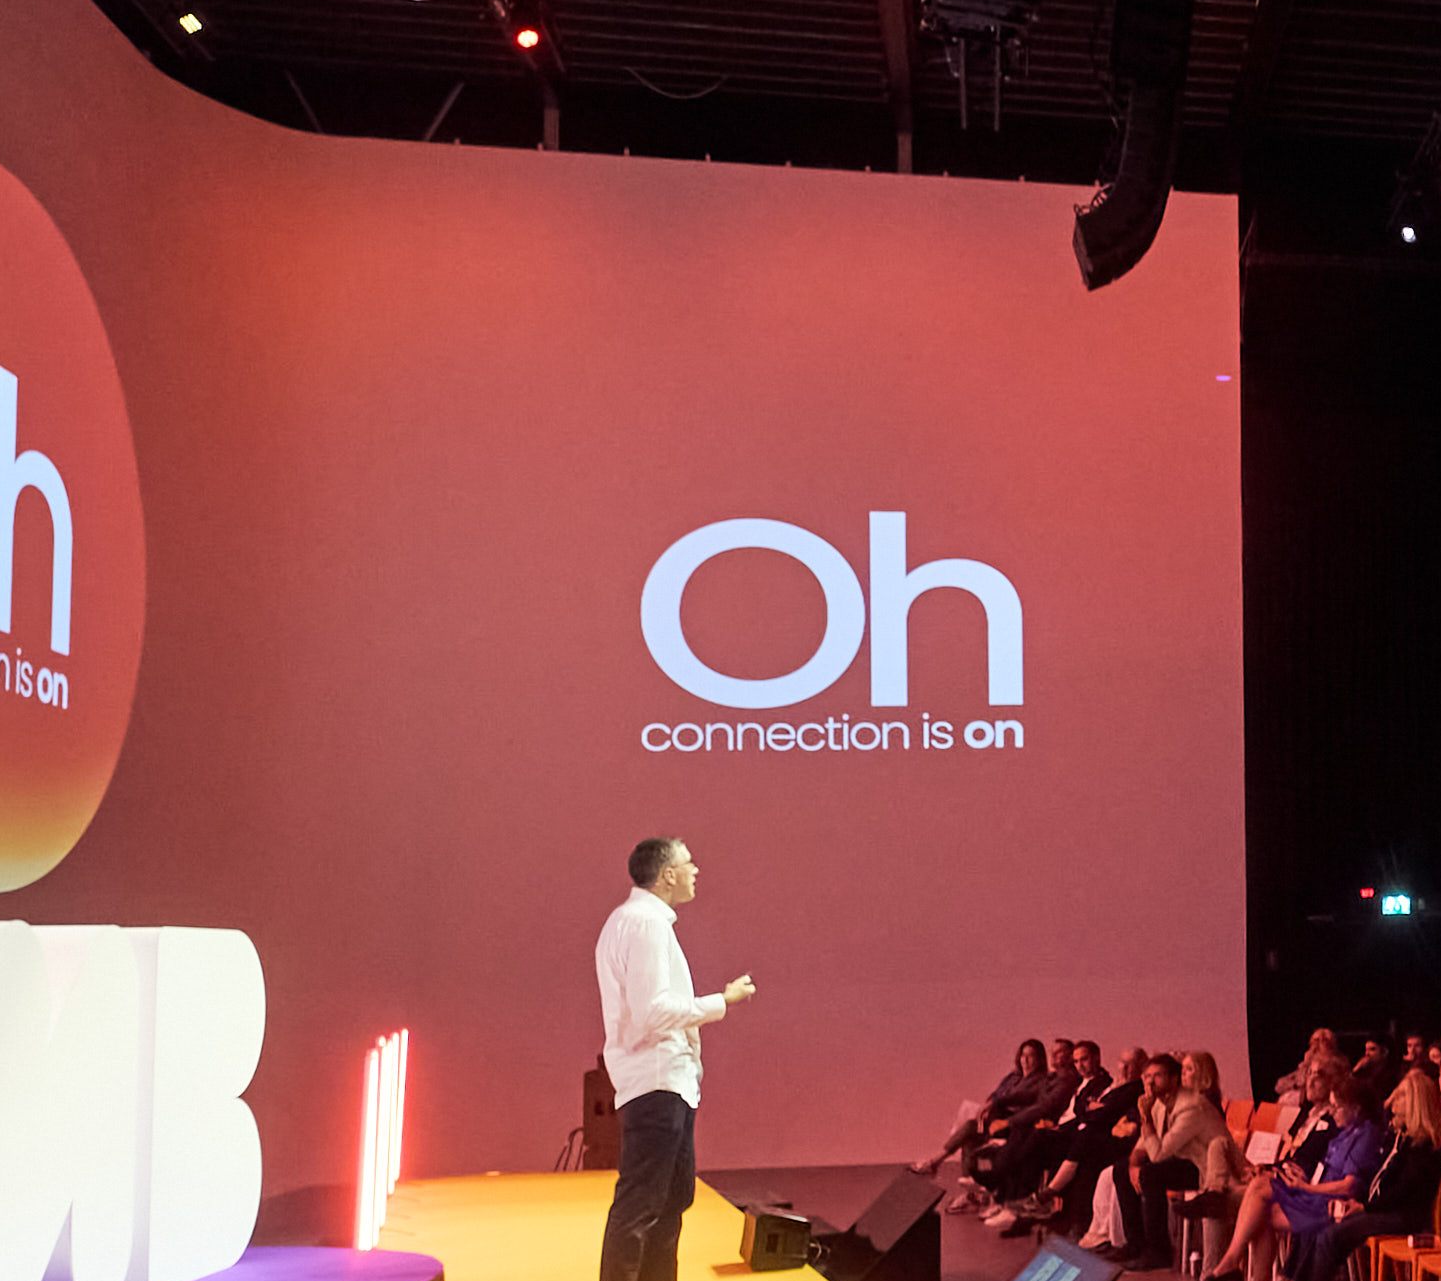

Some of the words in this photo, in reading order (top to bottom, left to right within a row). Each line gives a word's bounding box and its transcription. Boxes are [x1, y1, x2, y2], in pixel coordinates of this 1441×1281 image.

[640, 510, 1024, 709] Oh
[14, 645, 33, 699] is
[36, 665, 70, 711] on
[641, 713, 910, 752] connection
[922, 712, 954, 751] is
[963, 719, 1024, 750] on
